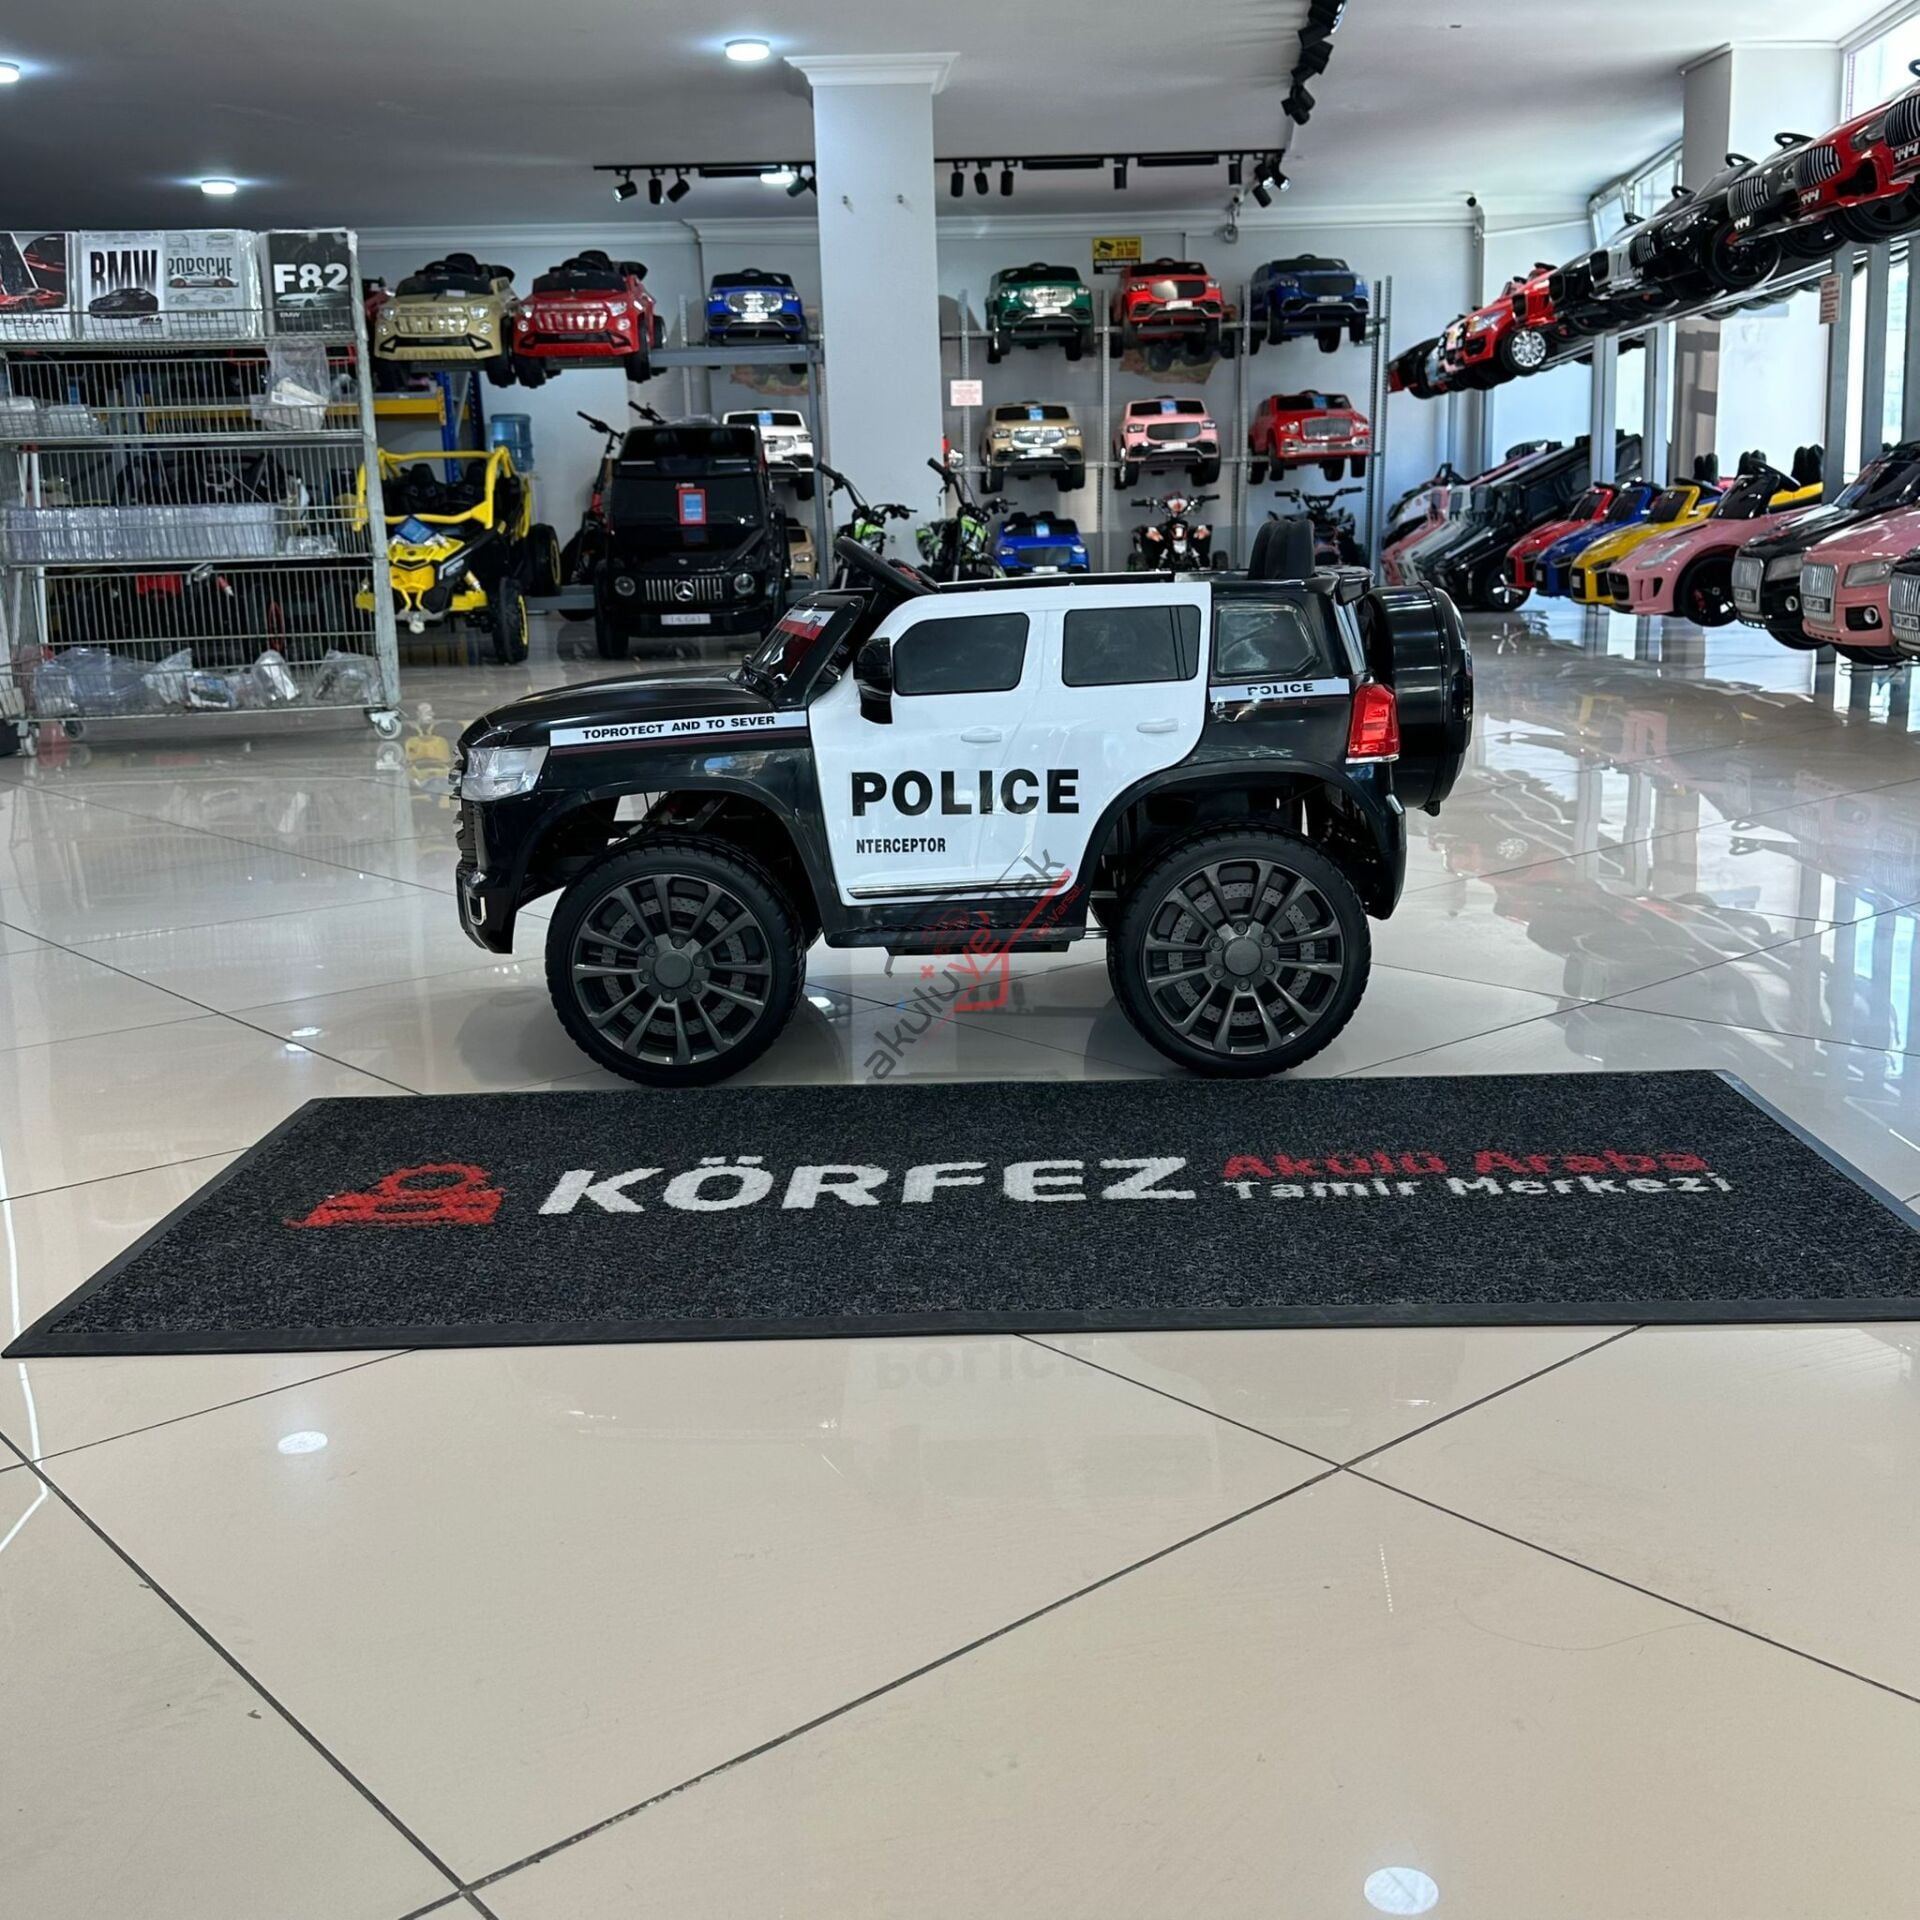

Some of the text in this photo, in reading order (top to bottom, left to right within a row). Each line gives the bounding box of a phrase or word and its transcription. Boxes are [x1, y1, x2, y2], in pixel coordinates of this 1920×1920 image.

[90, 250, 158, 297] BMW
[168, 257, 232, 277] PORSCHE
[273, 263, 348, 293] F82
[1247, 682, 1315, 697] POLICE
[583, 715, 776, 740] TOPROTECT AND TO SEVER
[851, 768, 1080, 817] POLICE
[856, 837, 946, 854] NTERCEPTOR
[1473, 1150, 1709, 1174] Araba
[538, 1155, 1197, 1215] KÖRFEZ
[1223, 1172, 1733, 1199] Tamir Merkezi
